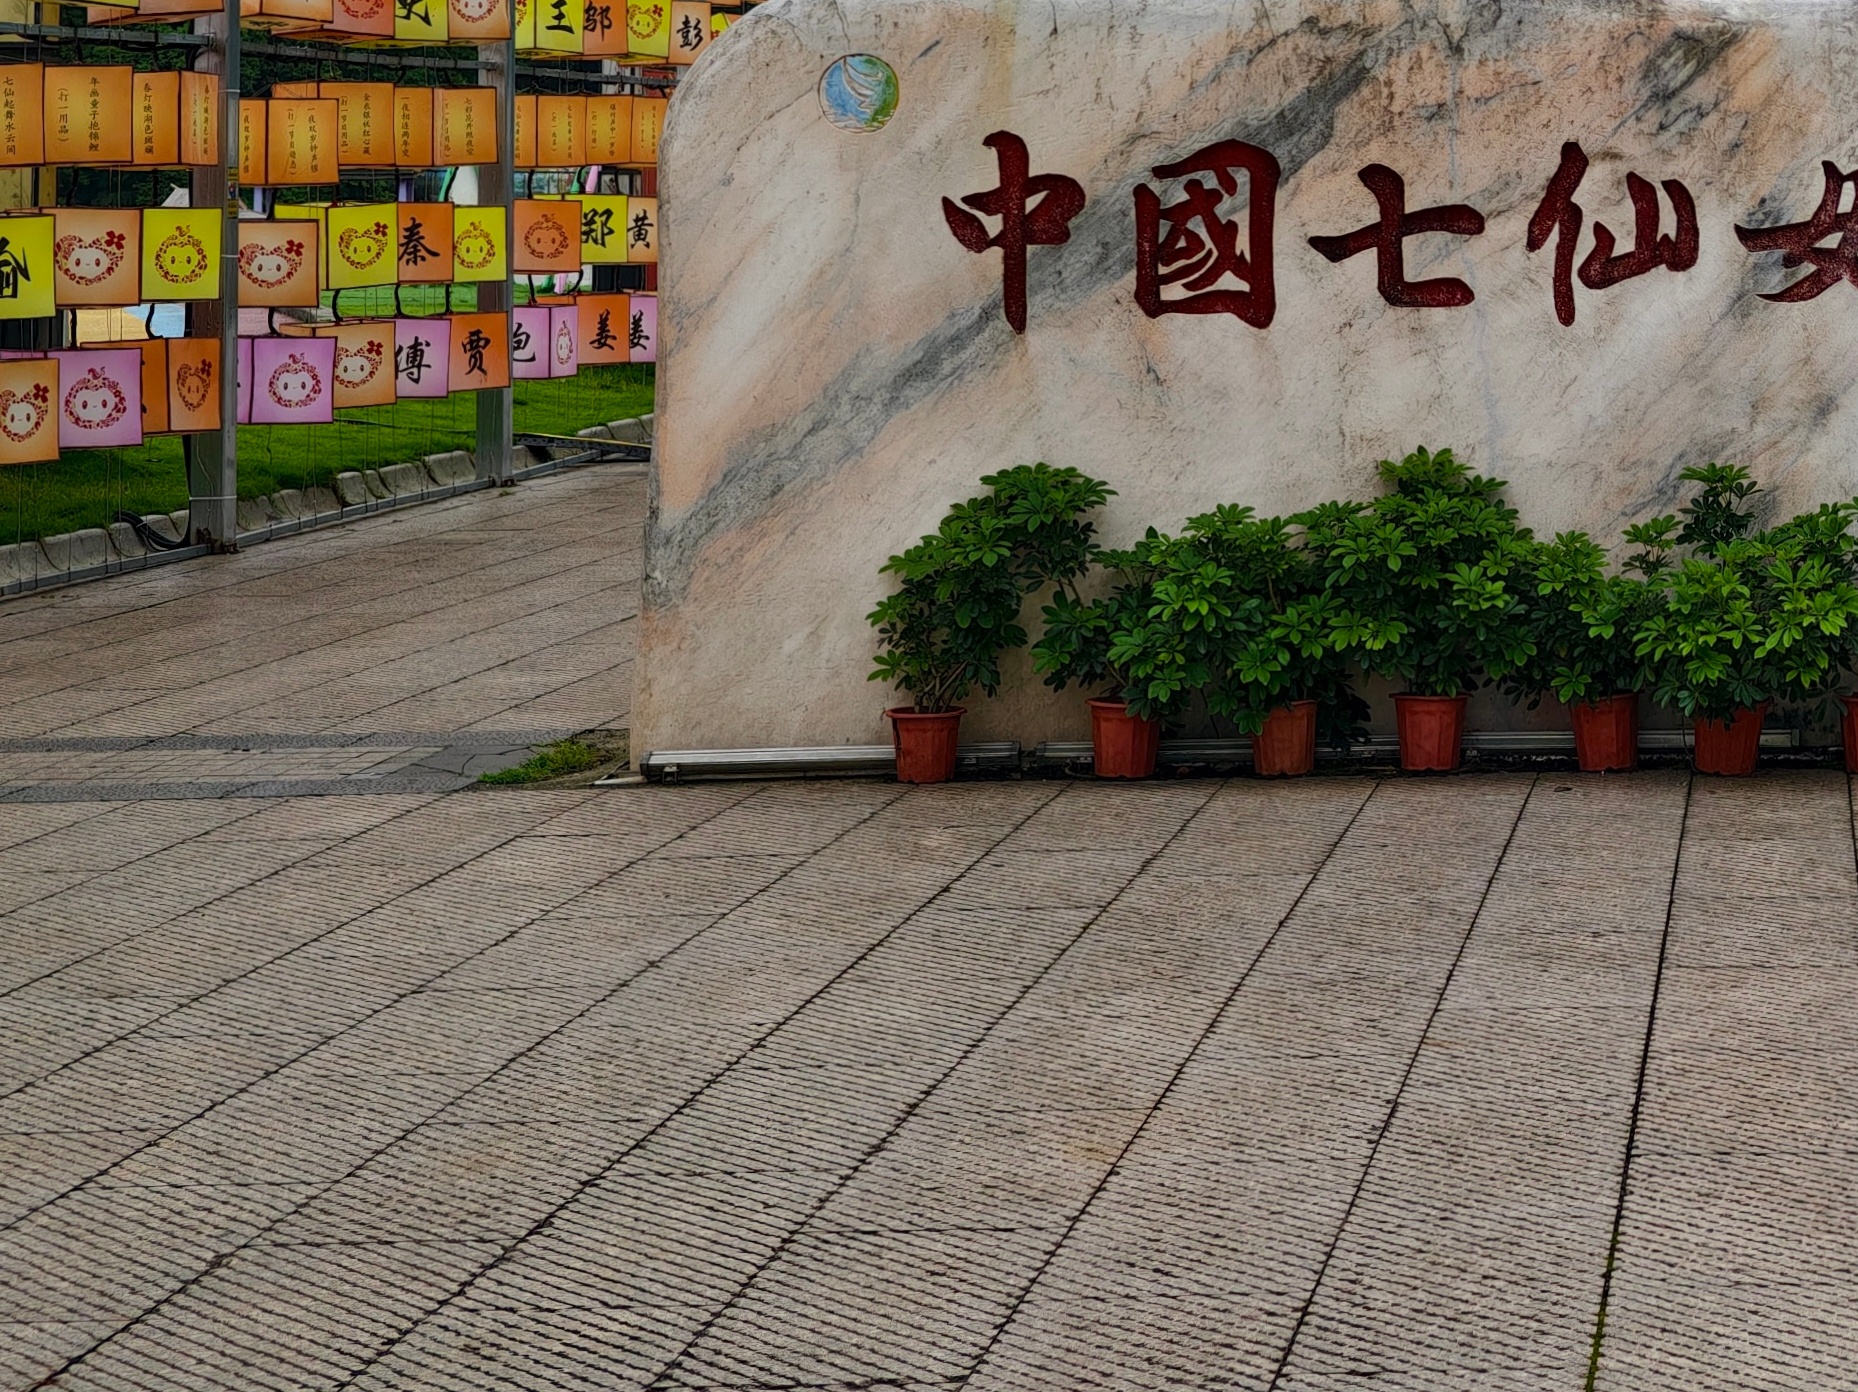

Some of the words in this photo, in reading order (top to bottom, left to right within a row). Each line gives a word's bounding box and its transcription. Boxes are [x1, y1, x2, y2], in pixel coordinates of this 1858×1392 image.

[676, 14, 704, 52] 彭
[398, 217, 440, 266] 秦
[627, 209, 654, 251] 黄
[589, 309, 618, 351] 姜
[461, 329, 491, 376] 贾
